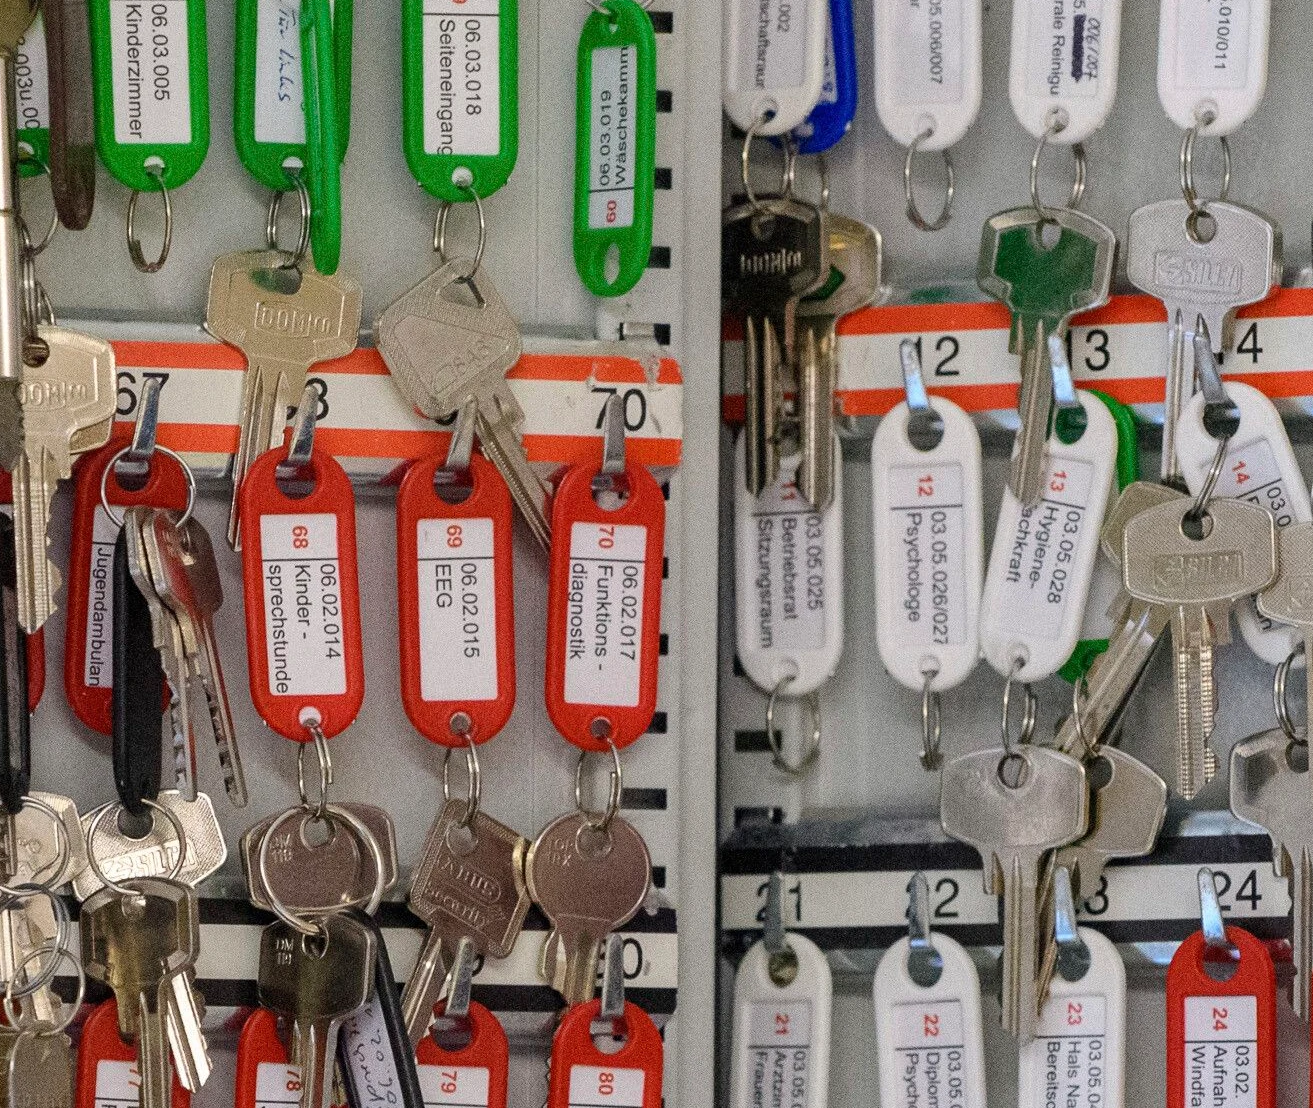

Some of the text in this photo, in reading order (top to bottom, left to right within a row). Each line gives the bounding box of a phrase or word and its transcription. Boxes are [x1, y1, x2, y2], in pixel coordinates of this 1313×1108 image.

[125, 4, 143, 139] Kinderzimmer
[151, 4, 170, 101] 06.03.005
[464, 19, 482, 115] 06.03.018
[599, 90, 611, 187] 06.03.019
[918, 475, 933, 495] 12
[1051, 471, 1066, 491] 13
[1232, 461, 1250, 485] 14
[292, 524, 308, 549] 68
[446, 525, 462, 549] 69
[599, 526, 614, 549] 70
[806, 512, 824, 609] 03.05.025
[905, 512, 921, 621] Psychologe
[1029, 506, 1058, 587] Hygiene-
[1047, 511, 1081, 604] 03.05.028
[294, 564, 311, 626] Kinder
[319, 563, 342, 659] 06.02.014
[434, 564, 452, 609] EEG
[460, 563, 480, 658] 06.02.015
[568, 563, 586, 660] diagnostik
[595, 565, 613, 658] Funktions
[620, 565, 638, 661] 06.02.017
[931, 511, 949, 645] 03.05.026/027
[268, 565, 290, 694] sprechstunde
[925, 1014, 939, 1037] 22
[1068, 1002, 1082, 1025] 23
[1213, 1007, 1227, 1031] 24
[441, 1071, 456, 1093] 79
[598, 1073, 612, 1094] 80
[1069, 1042, 1082, 1077] Hals
[1234, 1047, 1250, 1099] 03.02.
